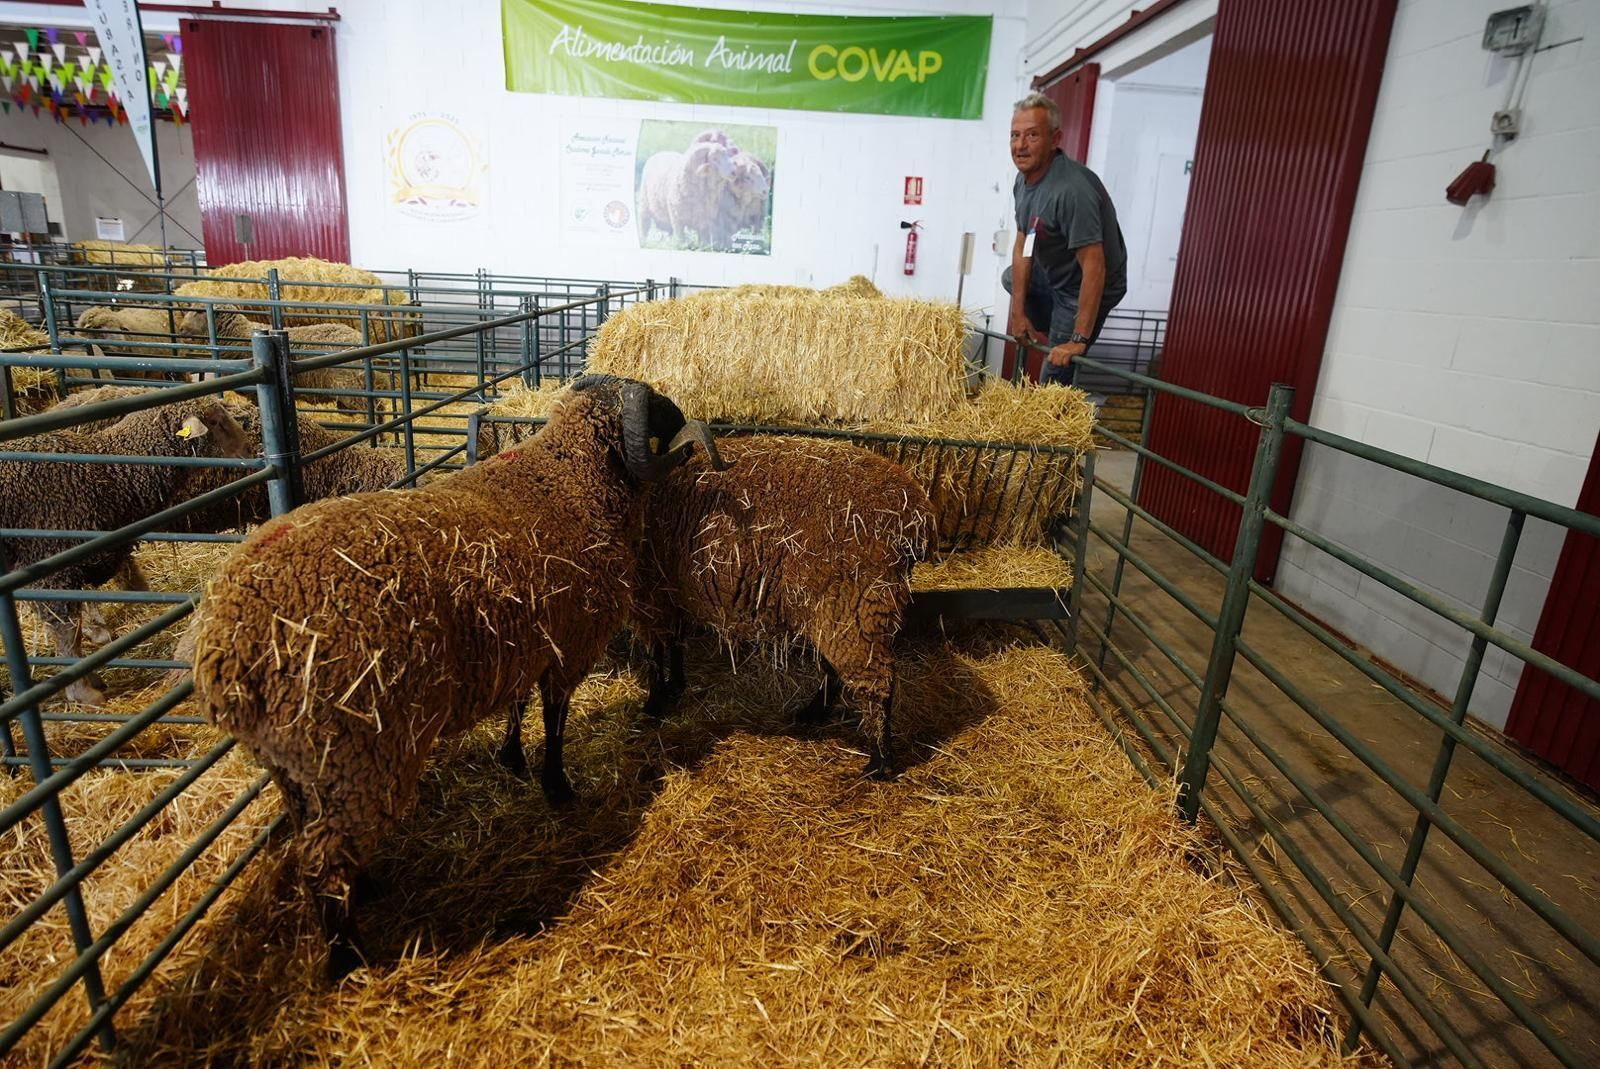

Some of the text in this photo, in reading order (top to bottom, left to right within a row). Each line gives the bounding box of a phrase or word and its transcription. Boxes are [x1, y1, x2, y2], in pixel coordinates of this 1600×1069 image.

[549, 25, 943, 83] Alimentación Animal COVAP
